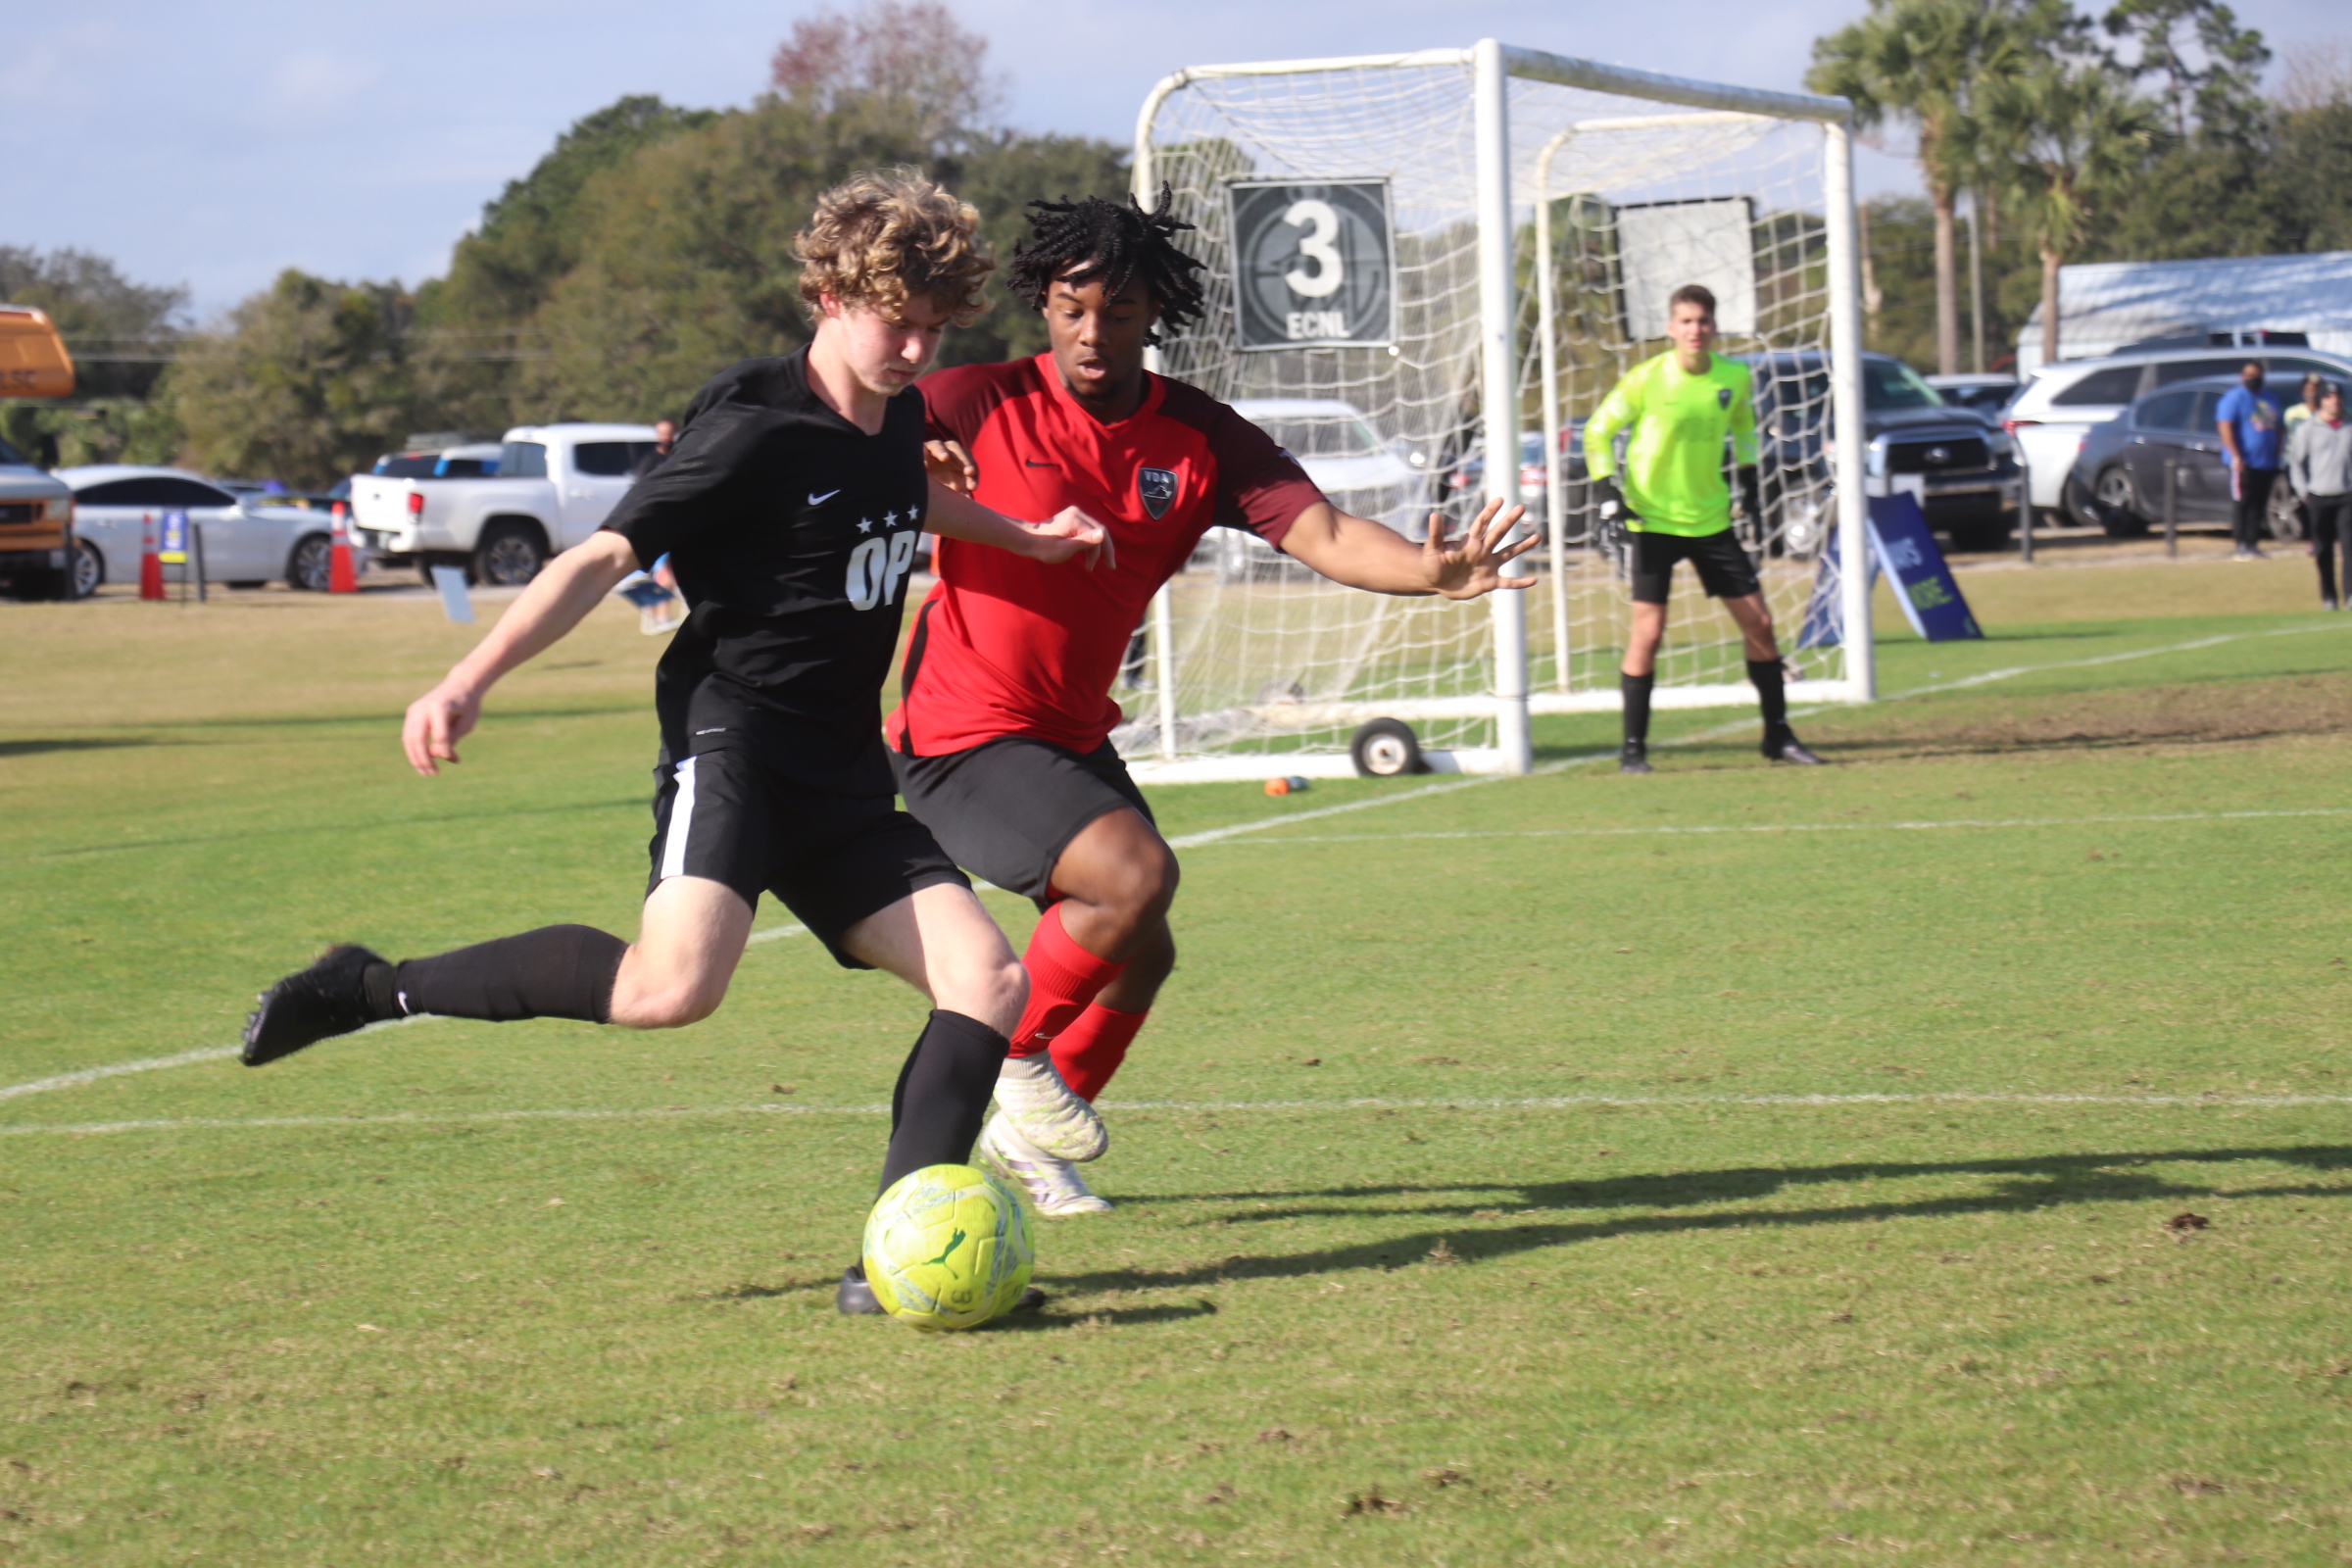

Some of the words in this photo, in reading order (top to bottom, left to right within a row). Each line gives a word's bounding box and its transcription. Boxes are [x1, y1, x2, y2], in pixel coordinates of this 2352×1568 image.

[1283, 199, 1344, 298] 3
[1286, 311, 1351, 339] ECNL
[845, 530, 916, 612] OP
